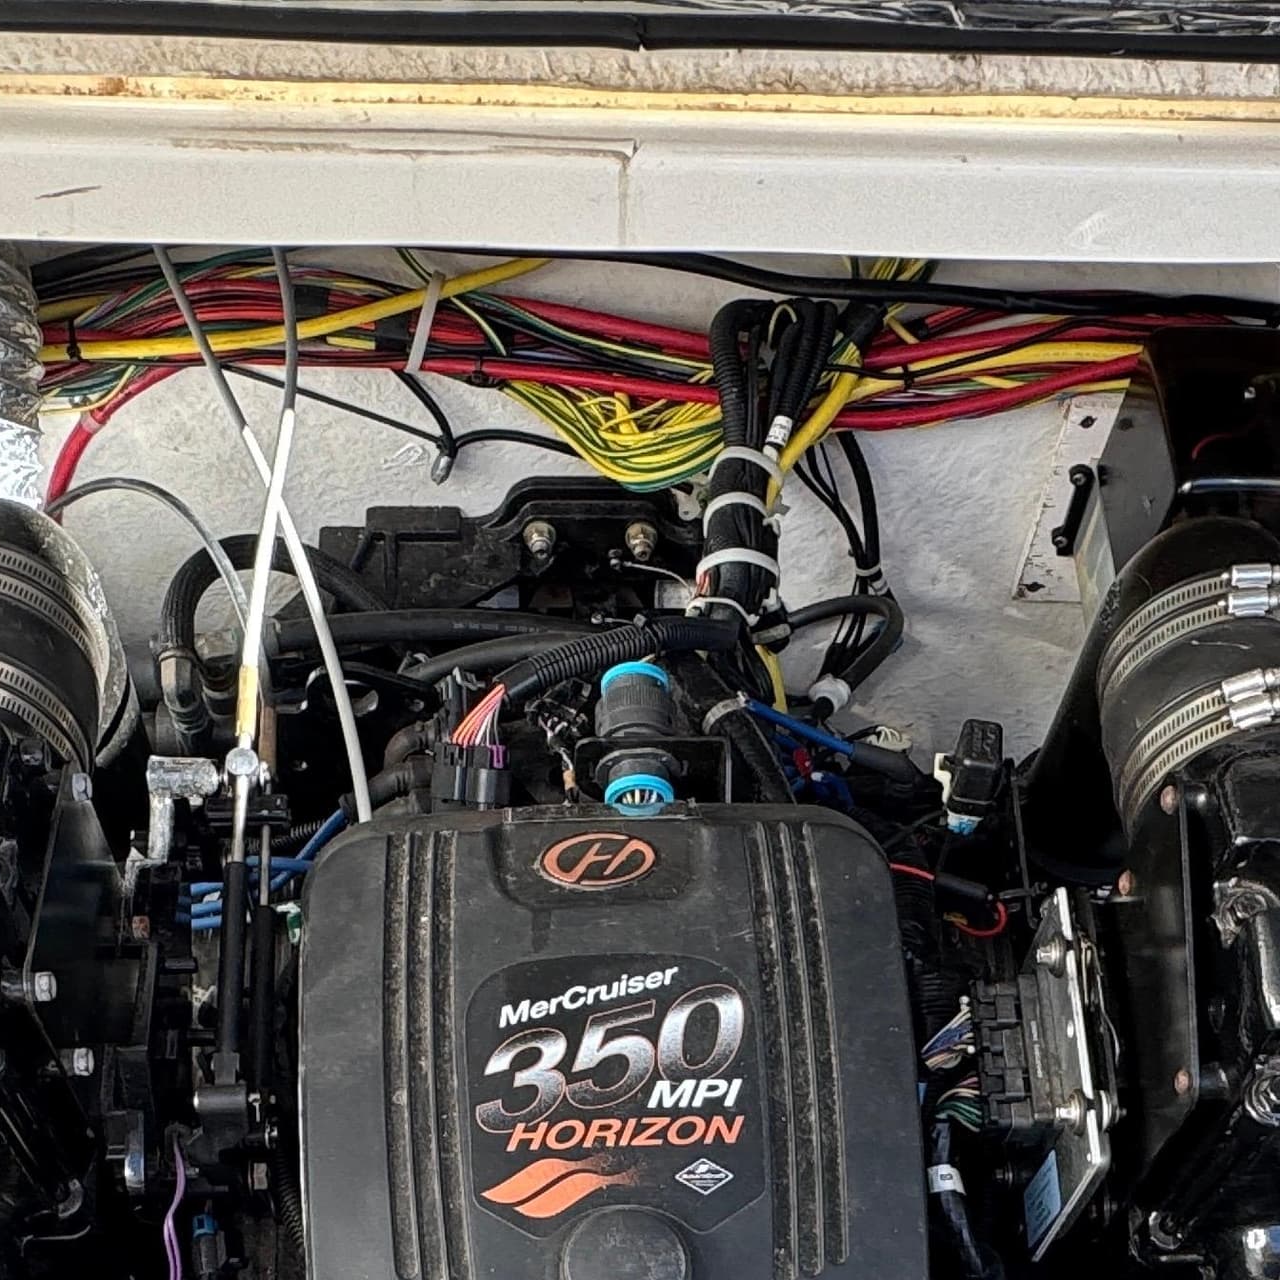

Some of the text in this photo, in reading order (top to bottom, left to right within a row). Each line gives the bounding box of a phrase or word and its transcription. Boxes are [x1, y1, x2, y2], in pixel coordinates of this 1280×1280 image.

[499, 966, 679, 1029] MerCruiser
[475, 983, 745, 1133] 350
[647, 1078, 743, 1108] MPI
[506, 1115, 745, 1152] HORIZON
